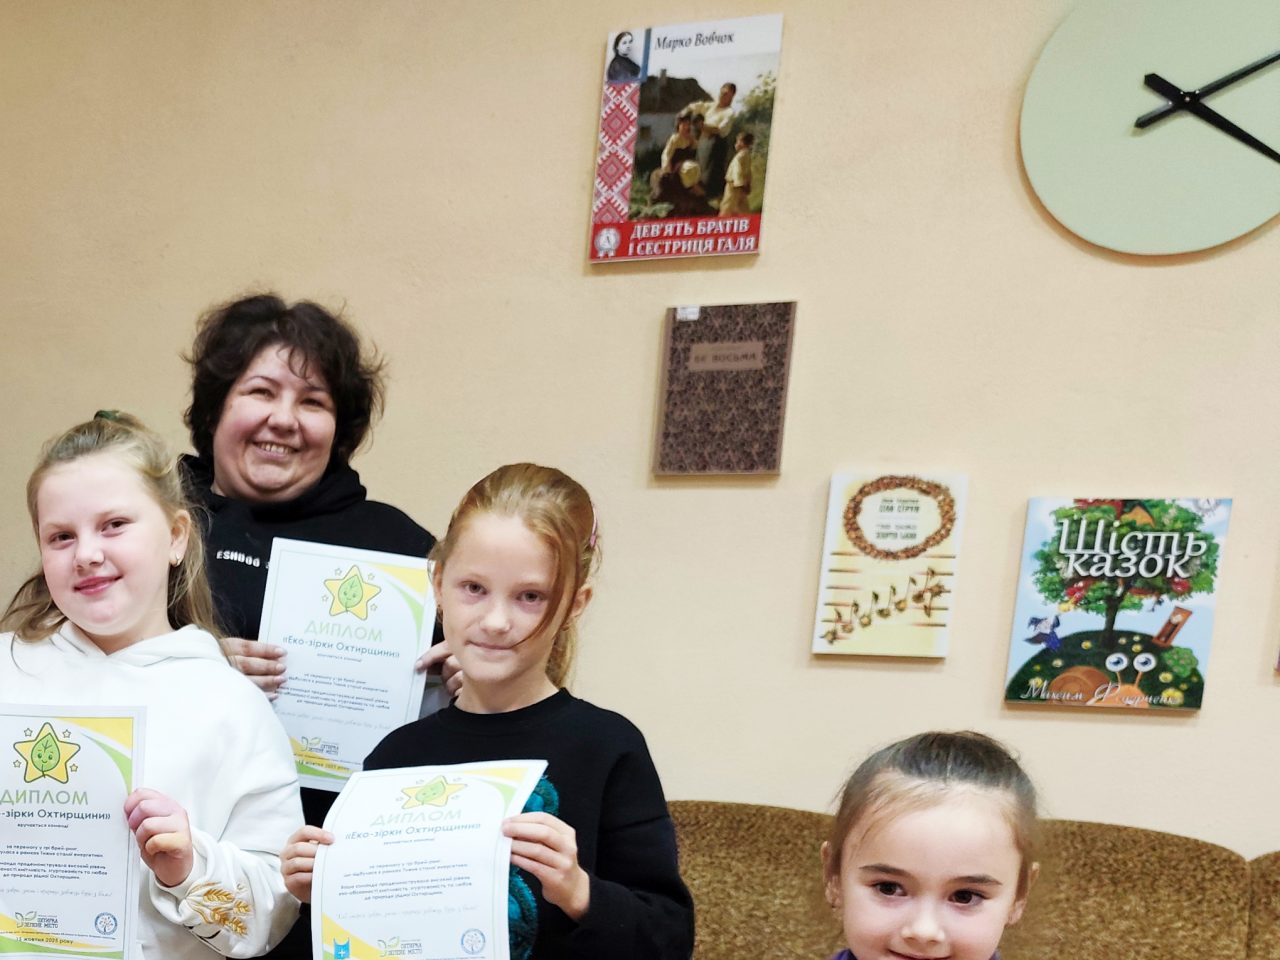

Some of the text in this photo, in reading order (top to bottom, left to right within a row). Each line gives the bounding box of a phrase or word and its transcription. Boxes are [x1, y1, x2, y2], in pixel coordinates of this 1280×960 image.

[655, 31, 734, 52] Марко Вовчок
[630, 219, 750, 240] ДЕВ'ЯТЬ БРАТІВ
[636, 240, 713, 256] СЕСТРИЦЯ
[717, 236, 756, 251] ГАЛЯ
[1059, 518, 1208, 556] Шість
[1065, 552, 1192, 579] казок
[305, 620, 383, 643] ДИПЛОМ
[282, 635, 400, 658] «Еко-зірки Охтирщини»
[0, 789, 88, 805] ДИПЛОМ
[37, 809, 111, 821] Охтирщини»
[371, 810, 462, 827] ДИПЛОМ
[345, 823, 481, 841] «Еко-зірки Охтирщини»
